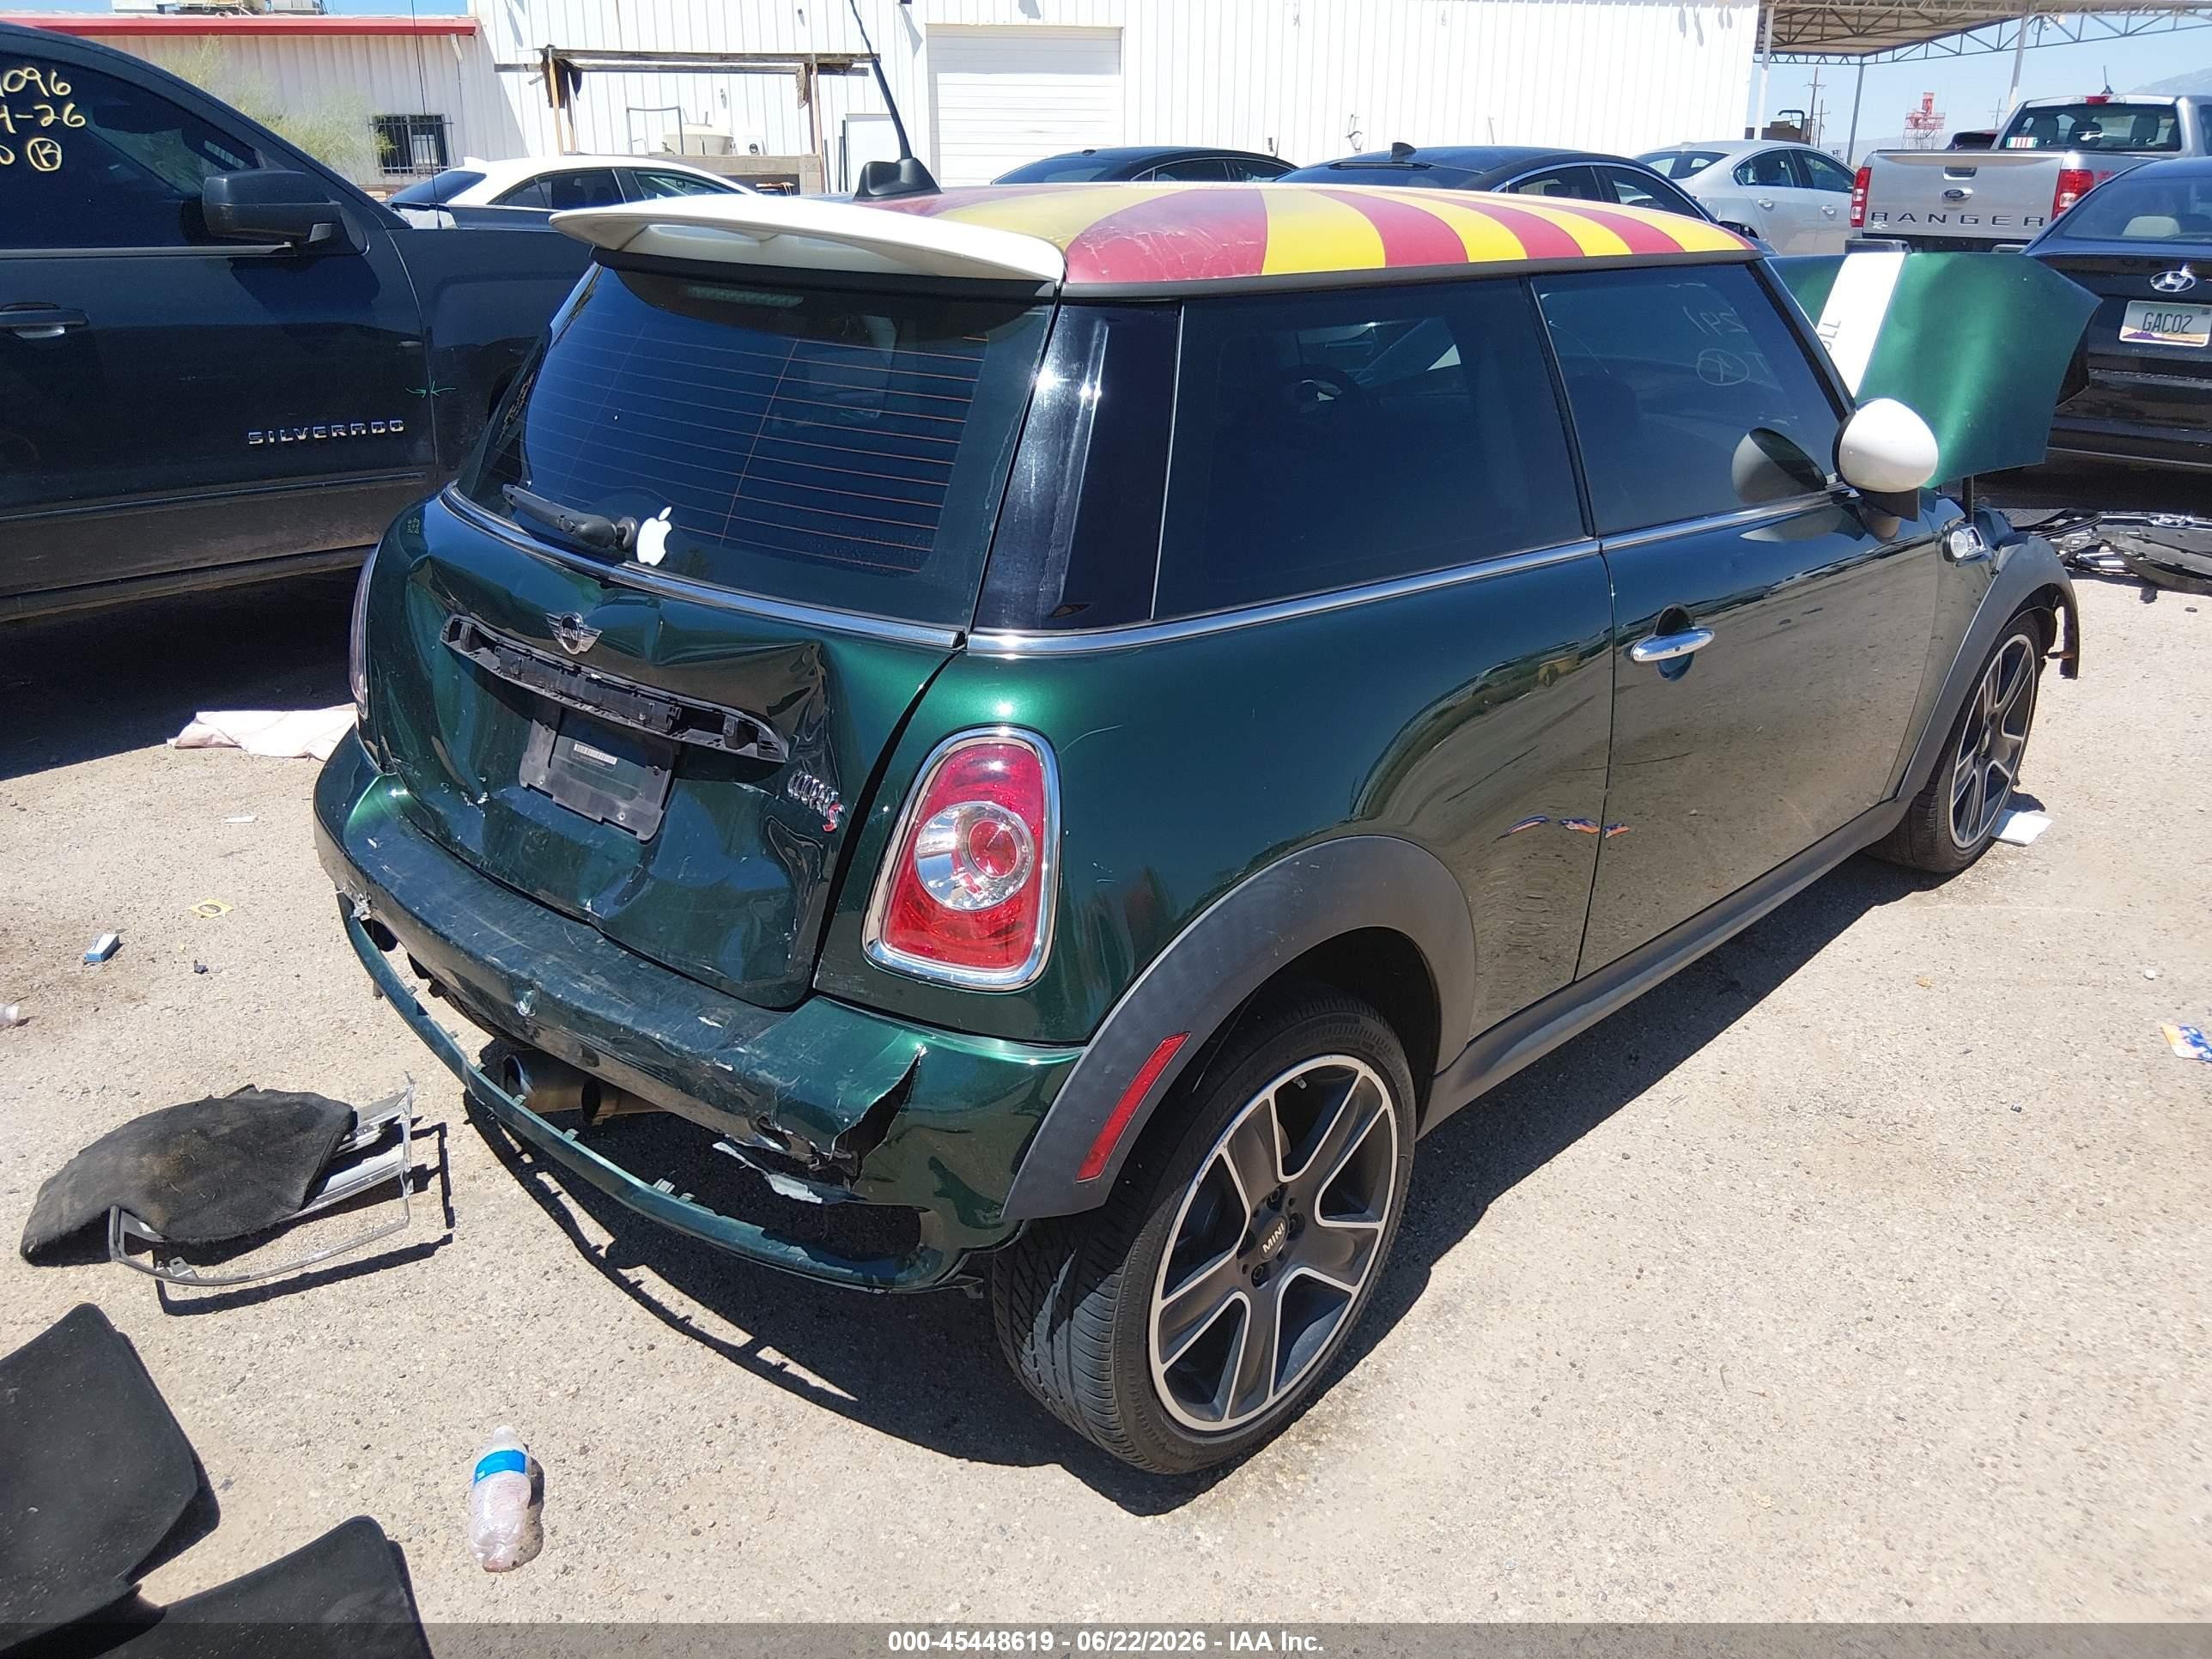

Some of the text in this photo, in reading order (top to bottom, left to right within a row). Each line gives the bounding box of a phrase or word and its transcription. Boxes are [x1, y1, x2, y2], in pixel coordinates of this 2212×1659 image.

[1870, 212, 2045, 227] RANGER
[248, 419, 404, 445] SILVERADO
[1262, 1222, 1285, 1254] MINI
